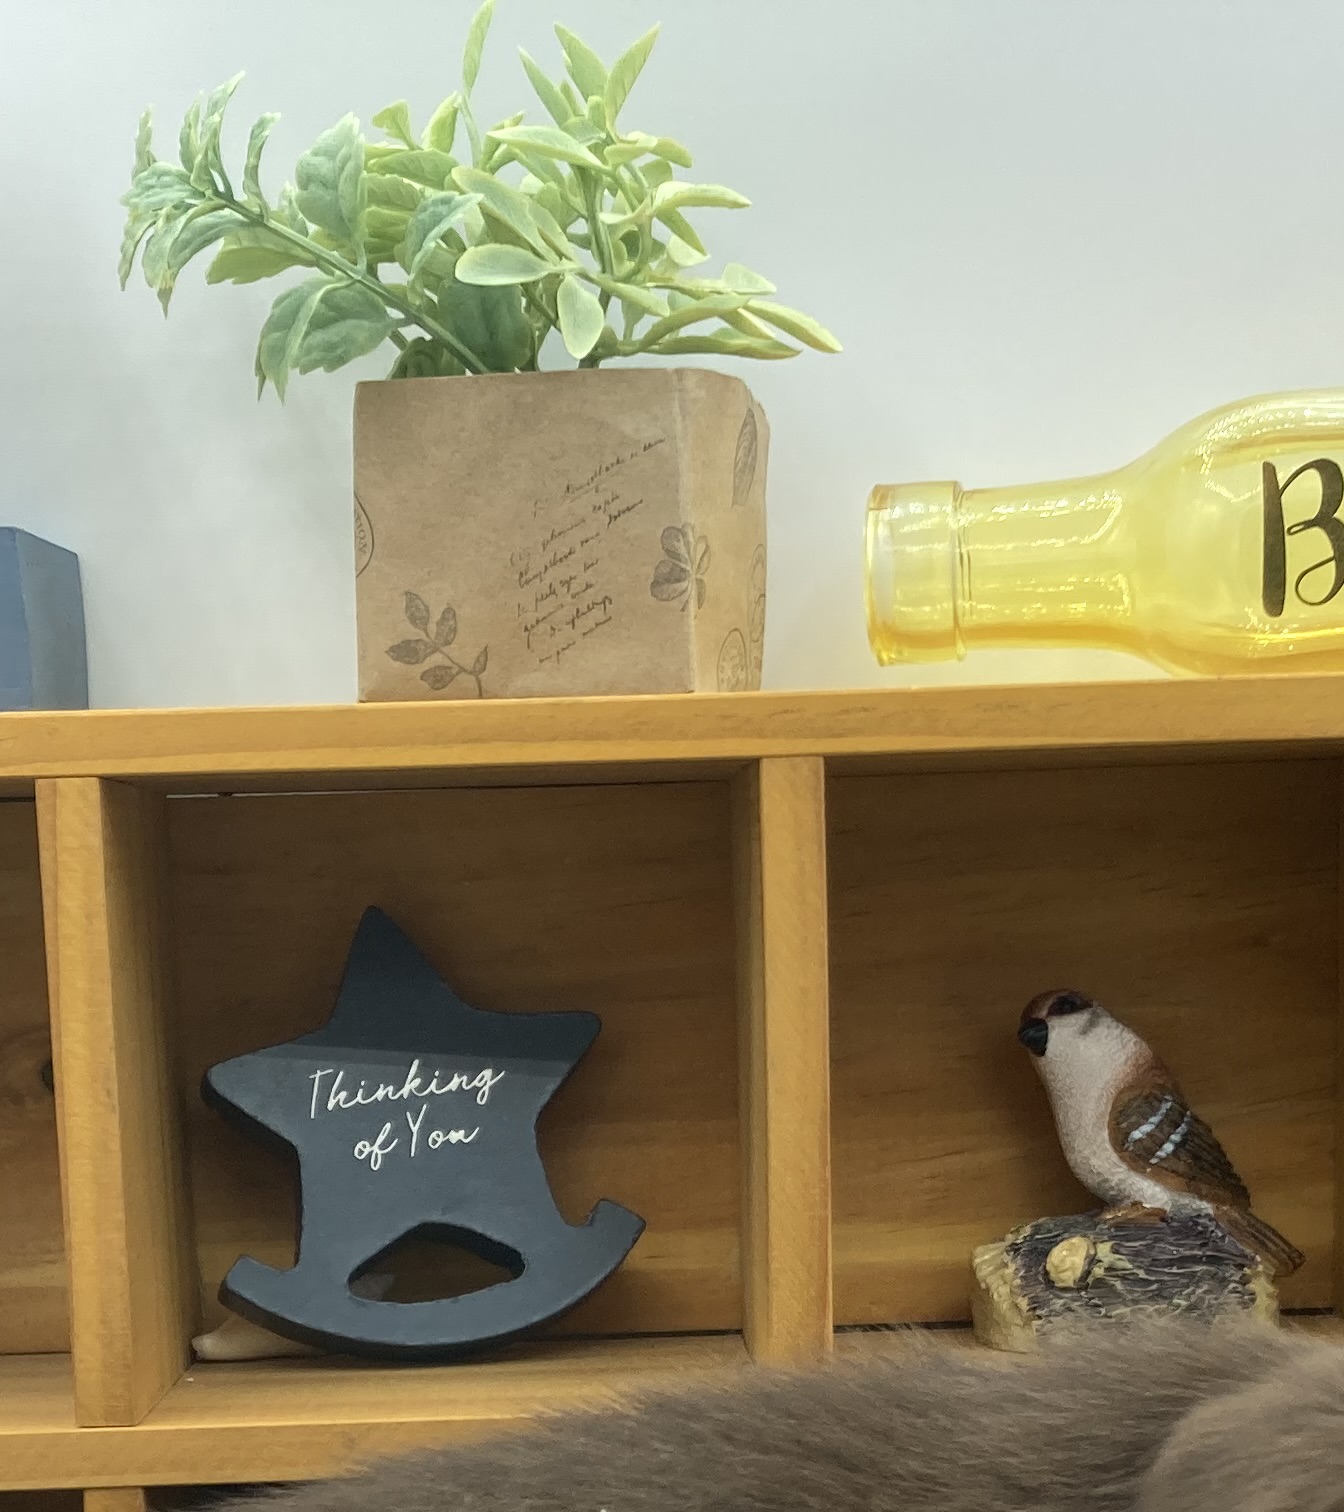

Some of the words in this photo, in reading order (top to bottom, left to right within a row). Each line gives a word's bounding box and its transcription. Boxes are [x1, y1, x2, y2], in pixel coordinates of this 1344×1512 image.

[308, 1058, 506, 1119] Thinking
[353, 1121, 399, 1171] of
[406, 1103, 480, 1158] You
